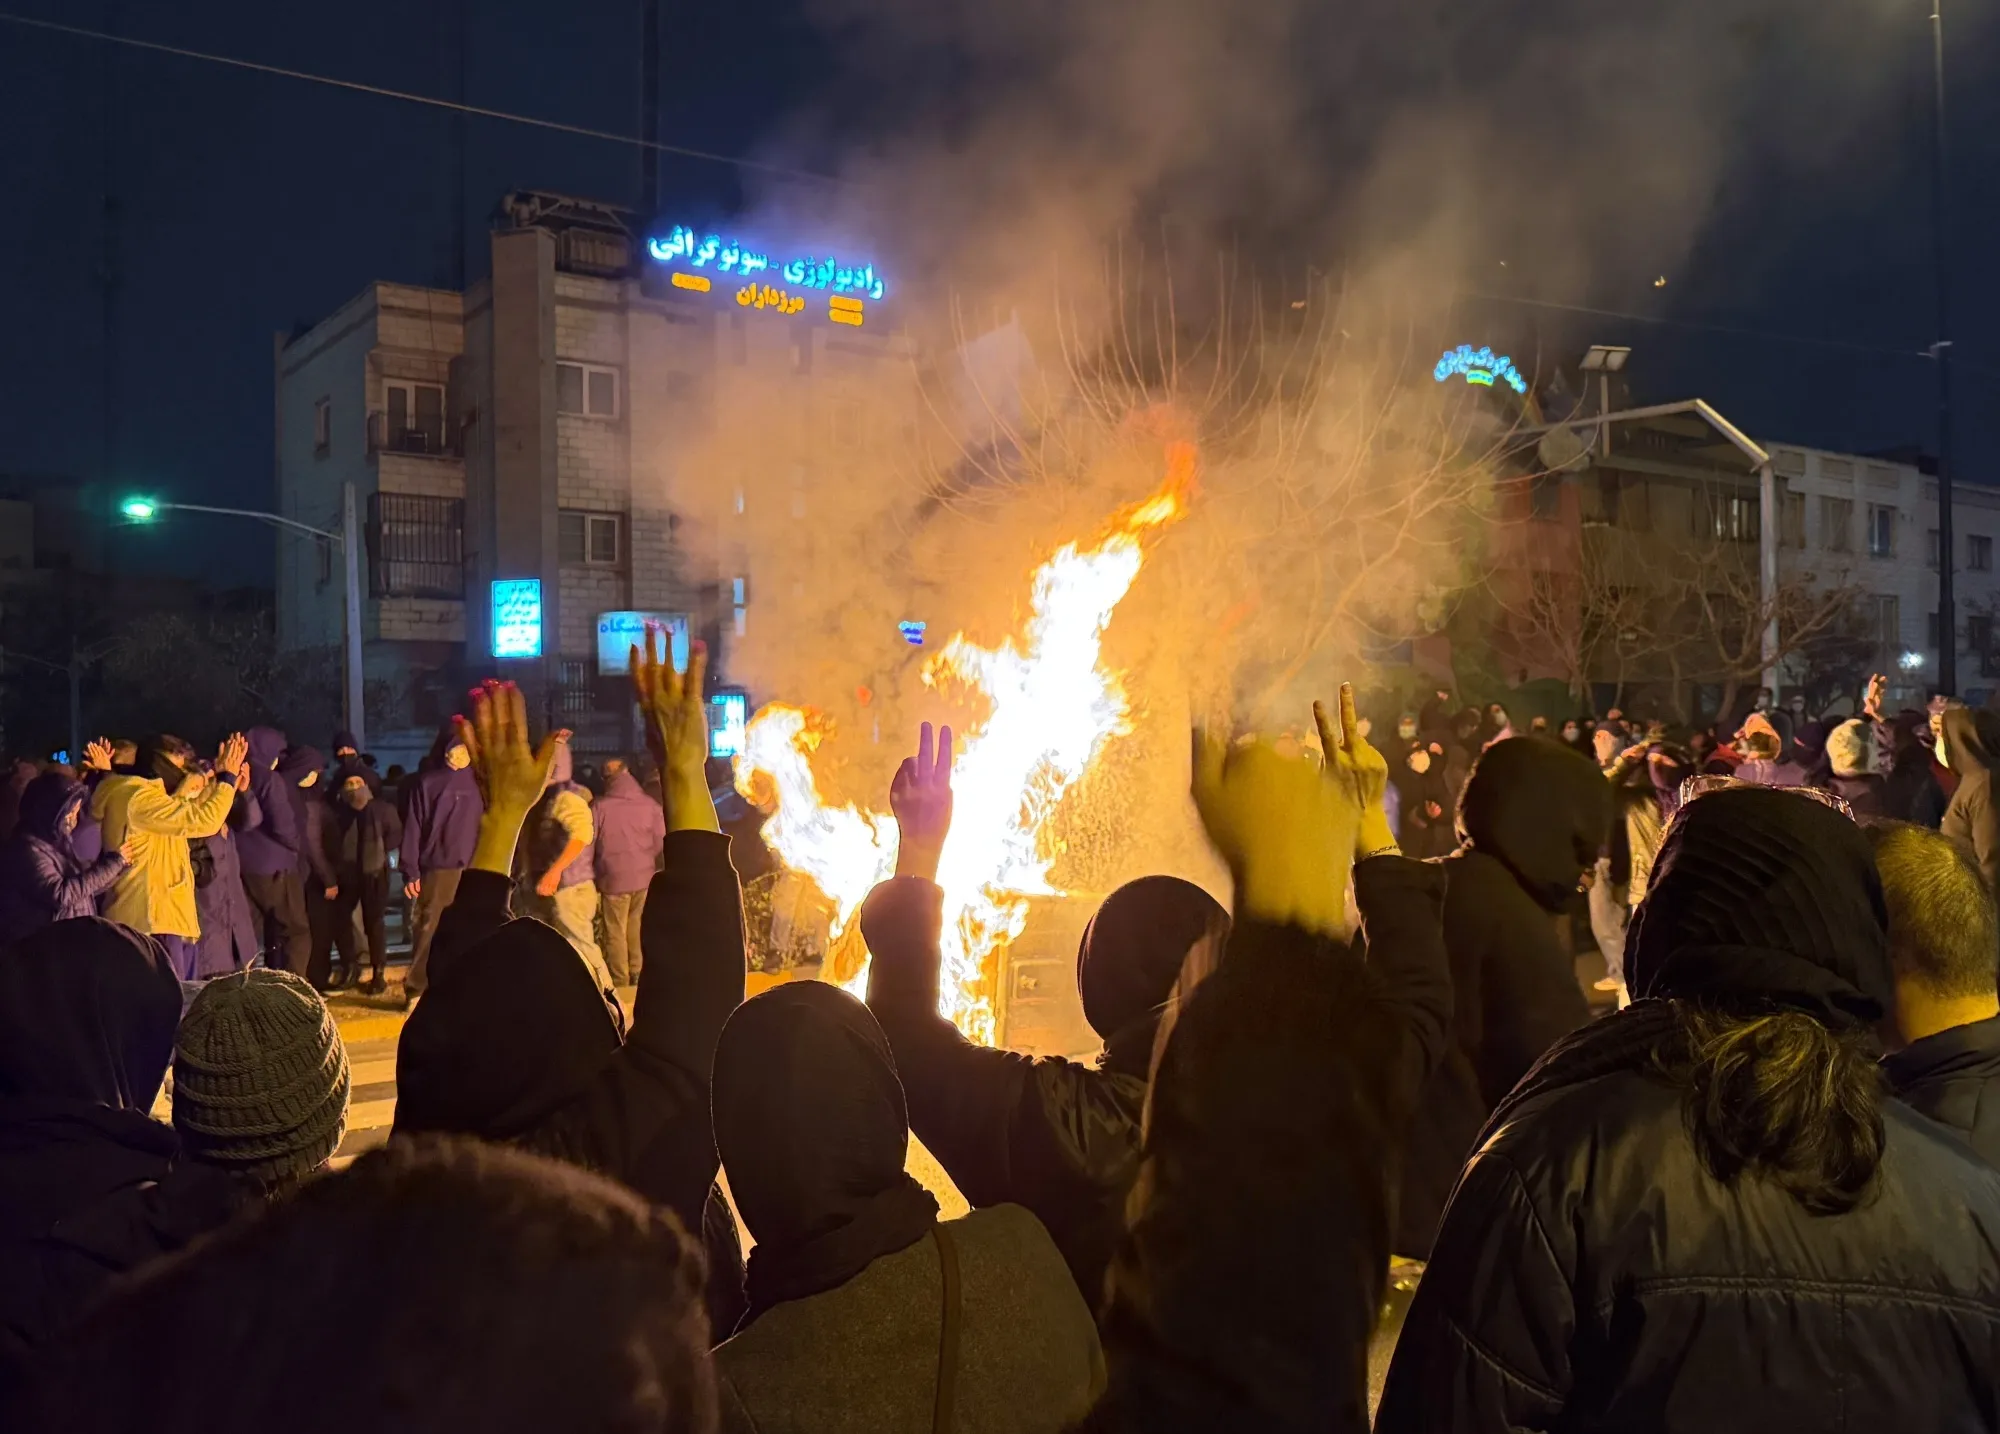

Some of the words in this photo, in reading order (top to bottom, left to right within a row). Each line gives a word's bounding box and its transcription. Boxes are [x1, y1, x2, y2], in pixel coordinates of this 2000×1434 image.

[649, 225, 768, 276] سونوگرافی
[736, 283, 805, 315] مرزداران
[783, 256, 885, 300] رادیولوژی
